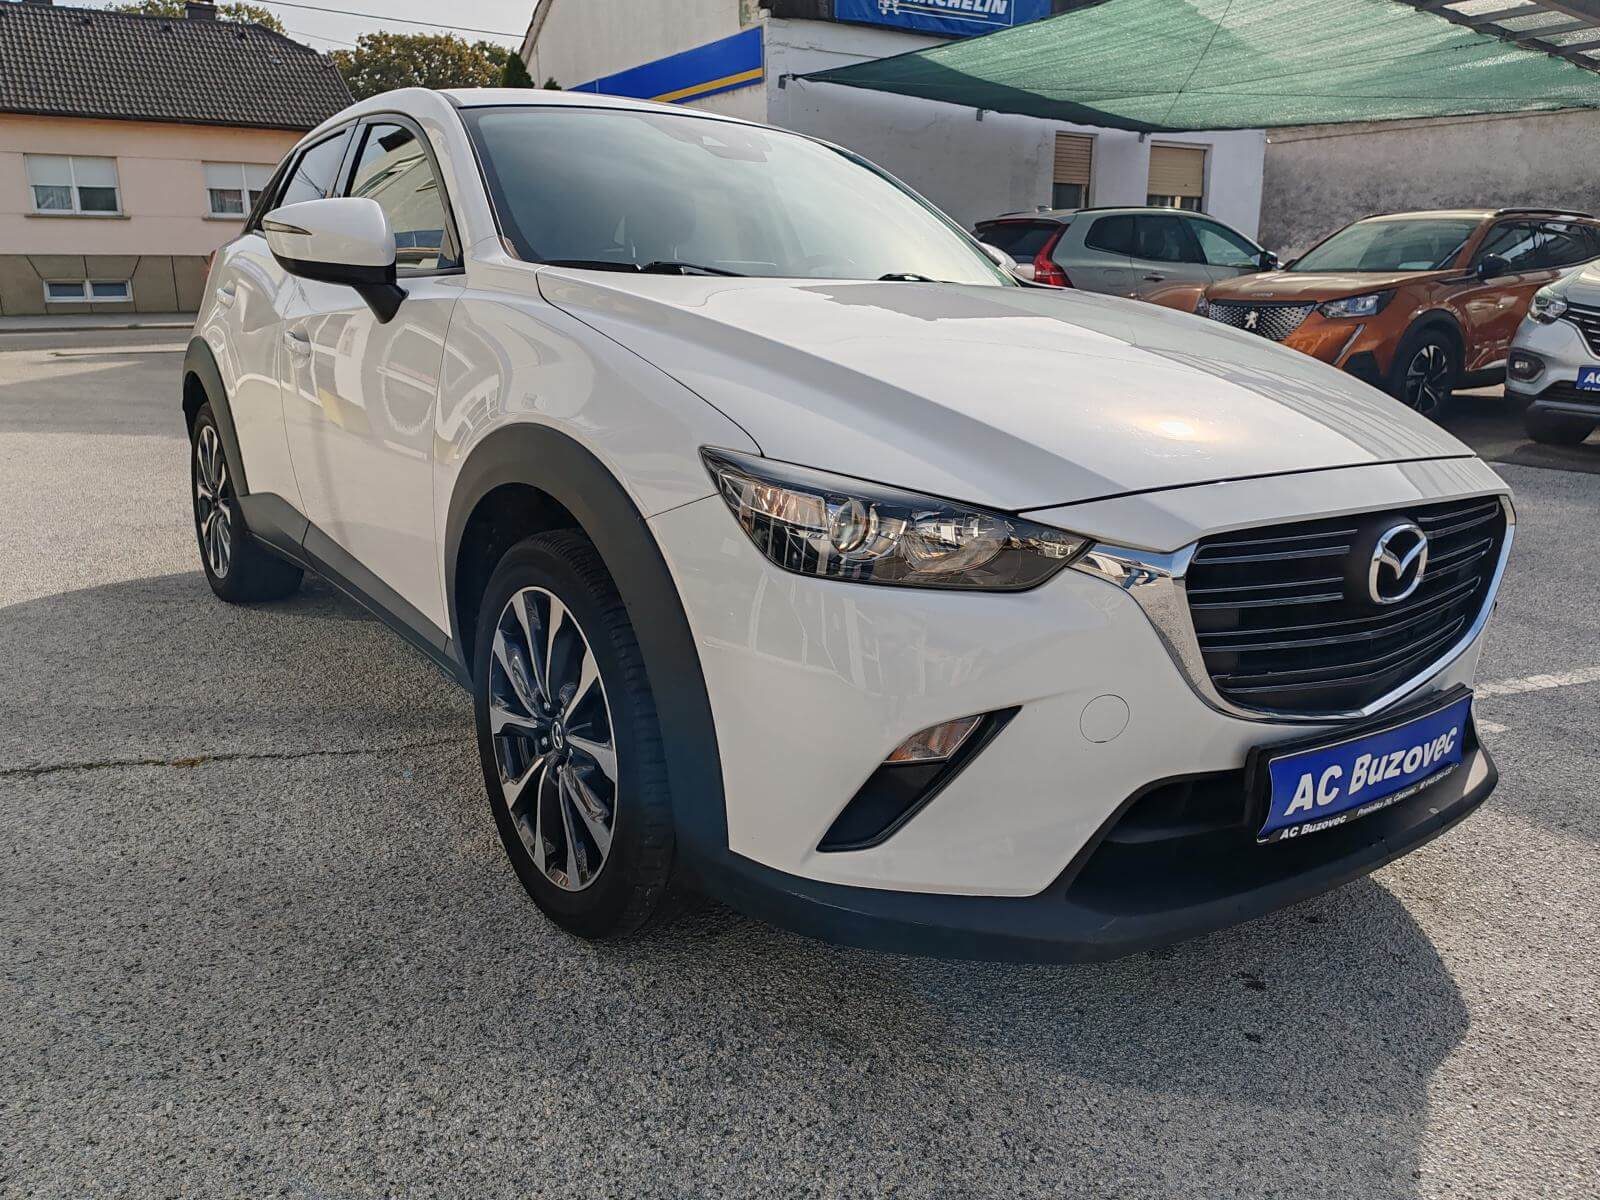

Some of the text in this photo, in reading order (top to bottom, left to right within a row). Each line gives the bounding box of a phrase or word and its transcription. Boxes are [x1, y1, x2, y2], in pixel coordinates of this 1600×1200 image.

[908, 0, 1008, 14] HELIN
[1283, 765, 1343, 816] AC
[1348, 727, 1458, 796] Buzovec
[1280, 815, 1347, 840] AC Buzovec
